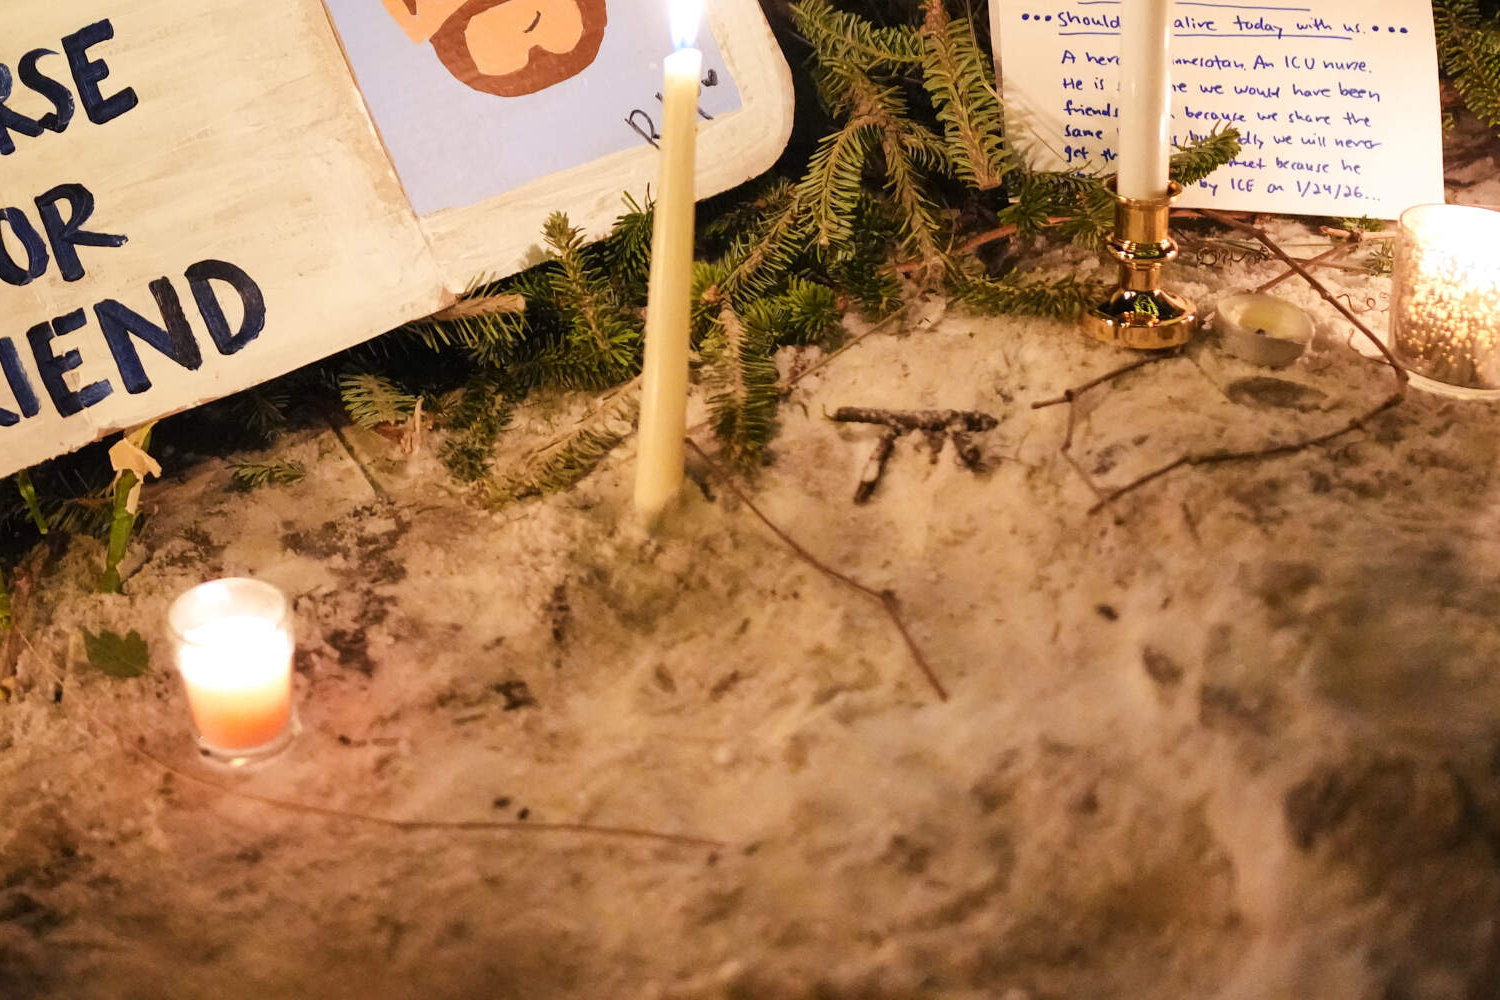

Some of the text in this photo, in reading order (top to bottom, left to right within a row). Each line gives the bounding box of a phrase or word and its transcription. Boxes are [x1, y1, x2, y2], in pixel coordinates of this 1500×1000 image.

[1173, 15, 1218, 31] alive
[1232, 14, 1283, 40] today
[1296, 16, 1333, 31] with
[1061, 49, 1077, 65] A
[1253, 54, 1275, 70] An
[1285, 55, 1316, 71] ICU
[1322, 60, 1373, 74] nurse.
[1062, 78, 1084, 91] He
[1093, 76, 1105, 91] is
[1199, 84, 1224, 95] we
[1233, 85, 1281, 99] would
[1292, 82, 1332, 98] have
[1338, 81, 1380, 103] been
[1184, 105, 1247, 123] because
[1256, 111, 1279, 122] we
[1288, 110, 1332, 126] share
[1342, 111, 1372, 128] the
[1064, 124, 1104, 140] same
[1273, 135, 1293, 145] we
[1300, 132, 1327, 148] will
[1064, 145, 1089, 163] get
[1228, 156, 1267, 170] meet
[1275, 156, 1331, 174] because
[1341, 158, 1362, 176] he
[1199, 178, 1219, 197] by
[1231, 177, 1255, 193] ICE
[1266, 183, 1285, 194] on
